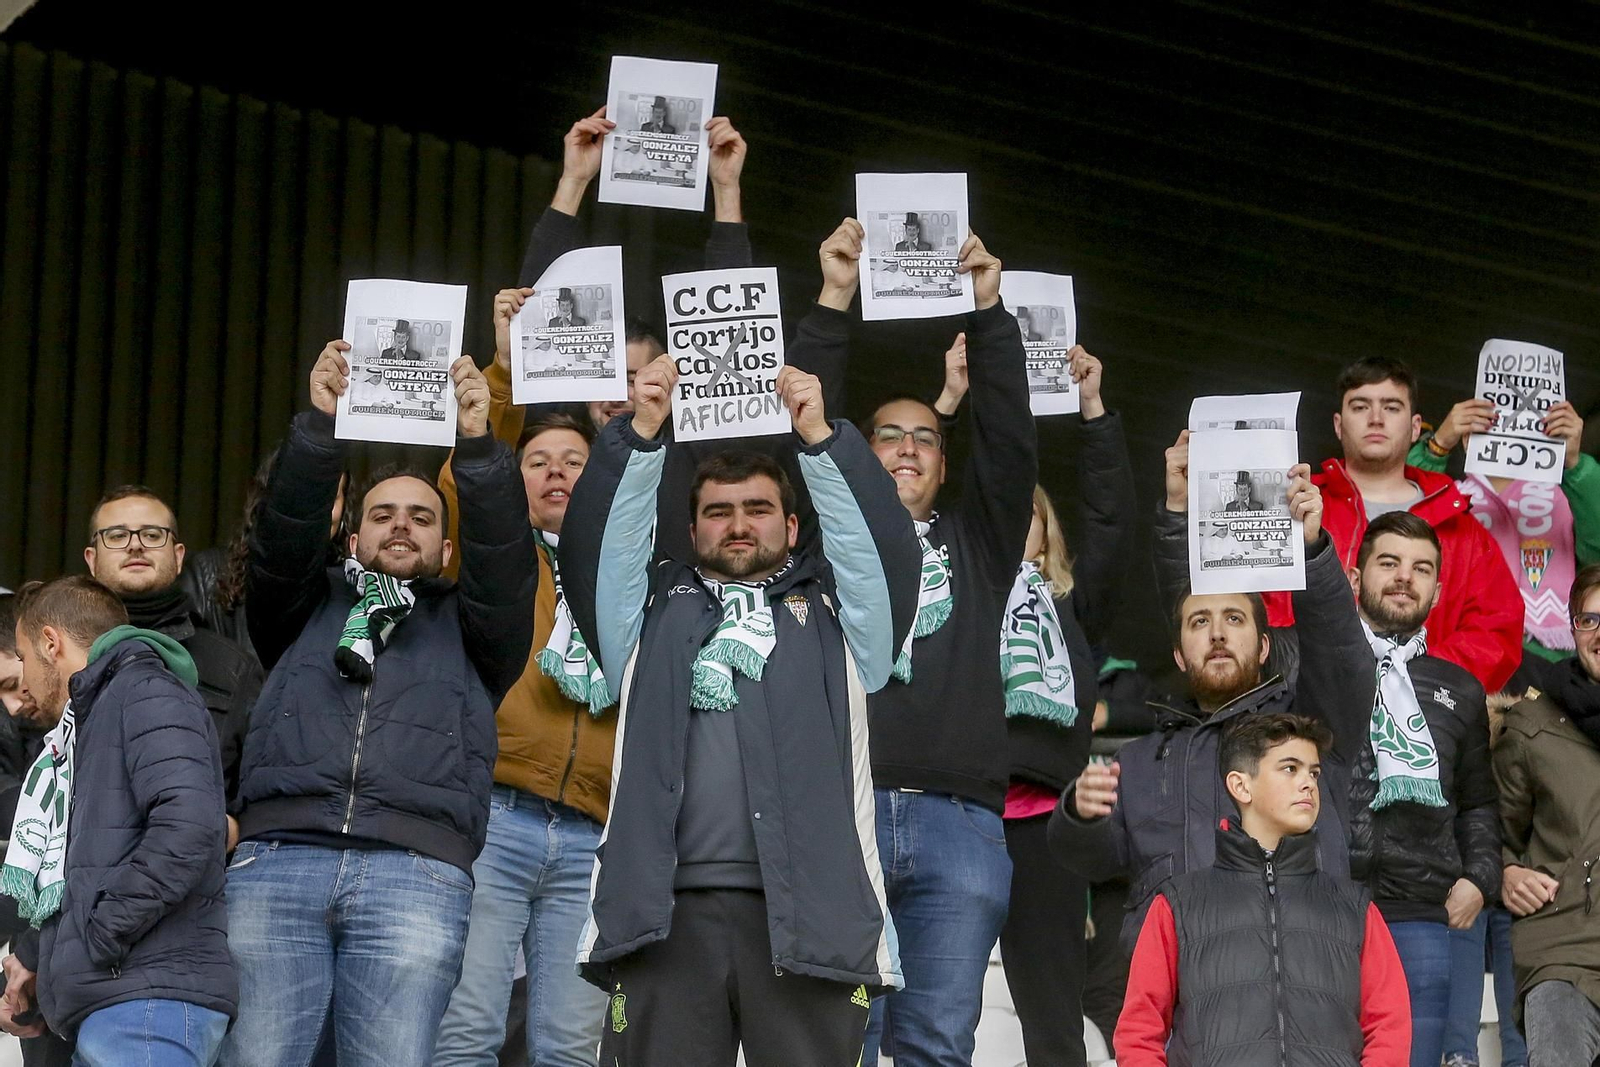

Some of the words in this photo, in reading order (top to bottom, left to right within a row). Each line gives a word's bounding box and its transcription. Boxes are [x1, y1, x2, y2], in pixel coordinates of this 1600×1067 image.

[642, 140, 698, 153] GONZALEZ
[647, 151, 675, 161] VETE
[677, 154, 692, 163] YA
[900, 259, 959, 268] GONZALEZ
[906, 268, 937, 277] VETE
[939, 268, 955, 277] YA
[574, 286, 605, 301] 500
[673, 282, 767, 316] C.C.F
[412, 320, 444, 337] 500
[553, 333, 613, 345] GONZALEZ
[558, 345, 591, 355] VETE
[592, 344, 609, 354] YA
[1026, 350, 1067, 360] NZALEZ
[675, 351, 778, 376] Calos
[1026, 361, 1046, 370] ETE
[1047, 360, 1063, 369] YA
[1484, 353, 1561, 377] AFICION
[384, 369, 447, 383] GONZALEZ
[388, 381, 422, 392] VETE
[424, 383, 441, 393] YA
[1483, 391, 1560, 412] alos
[679, 394, 782, 432] AFICION
[1477, 440, 1557, 470] C.C.F
[1252, 471, 1284, 486] 500
[1230, 520, 1291, 531] GONZALEZ
[1236, 531, 1268, 542] VETE
[1269, 531, 1287, 540] YA
